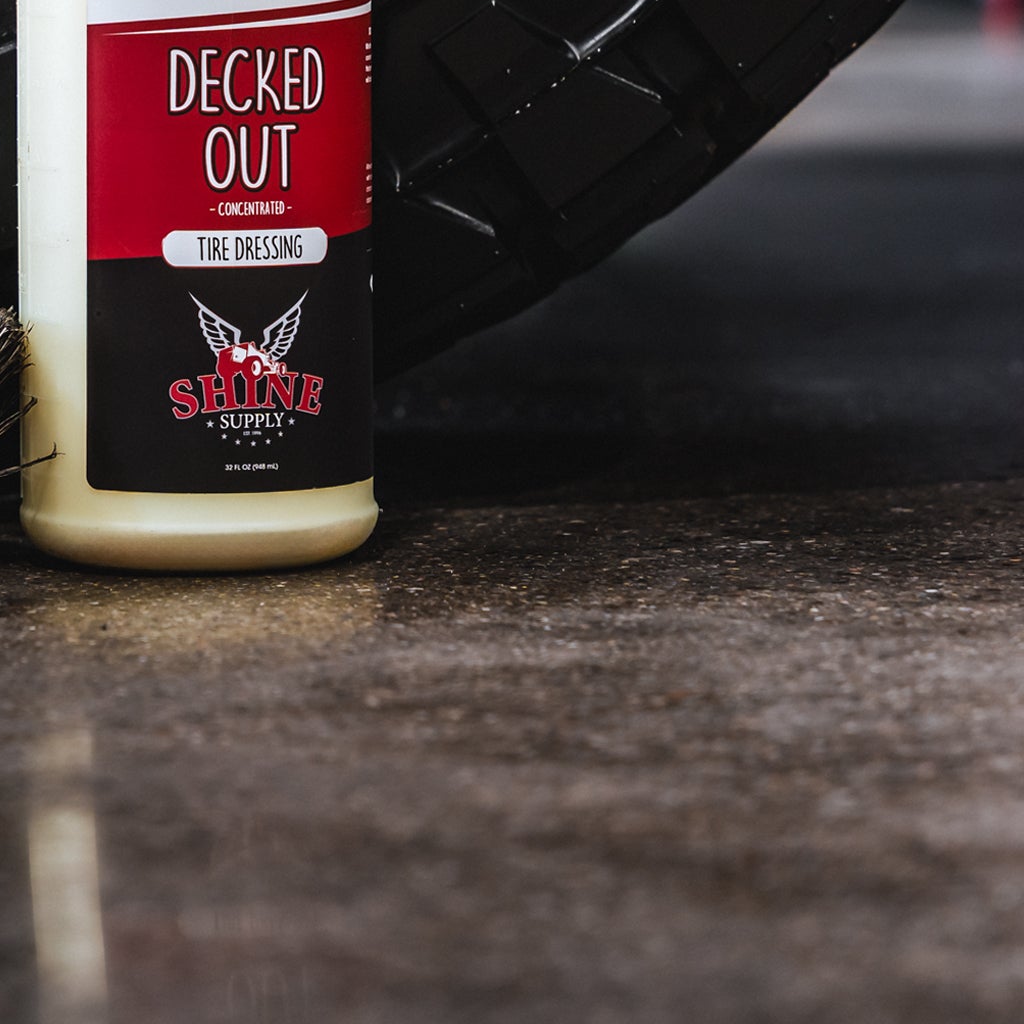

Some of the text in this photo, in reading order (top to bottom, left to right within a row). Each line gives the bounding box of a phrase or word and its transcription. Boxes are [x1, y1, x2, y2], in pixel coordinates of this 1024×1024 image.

[168, 46, 324, 114] DECKED
[204, 124, 298, 190] OUT
[217, 201, 285, 216] CONCENTRATED
[197, 235, 304, 261] TIRE DRESSING
[168, 372, 324, 419] SHINE
[219, 412, 285, 429] SUPPLY
[224, 463, 234, 471] 32
[241, 463, 251, 471] OZ
